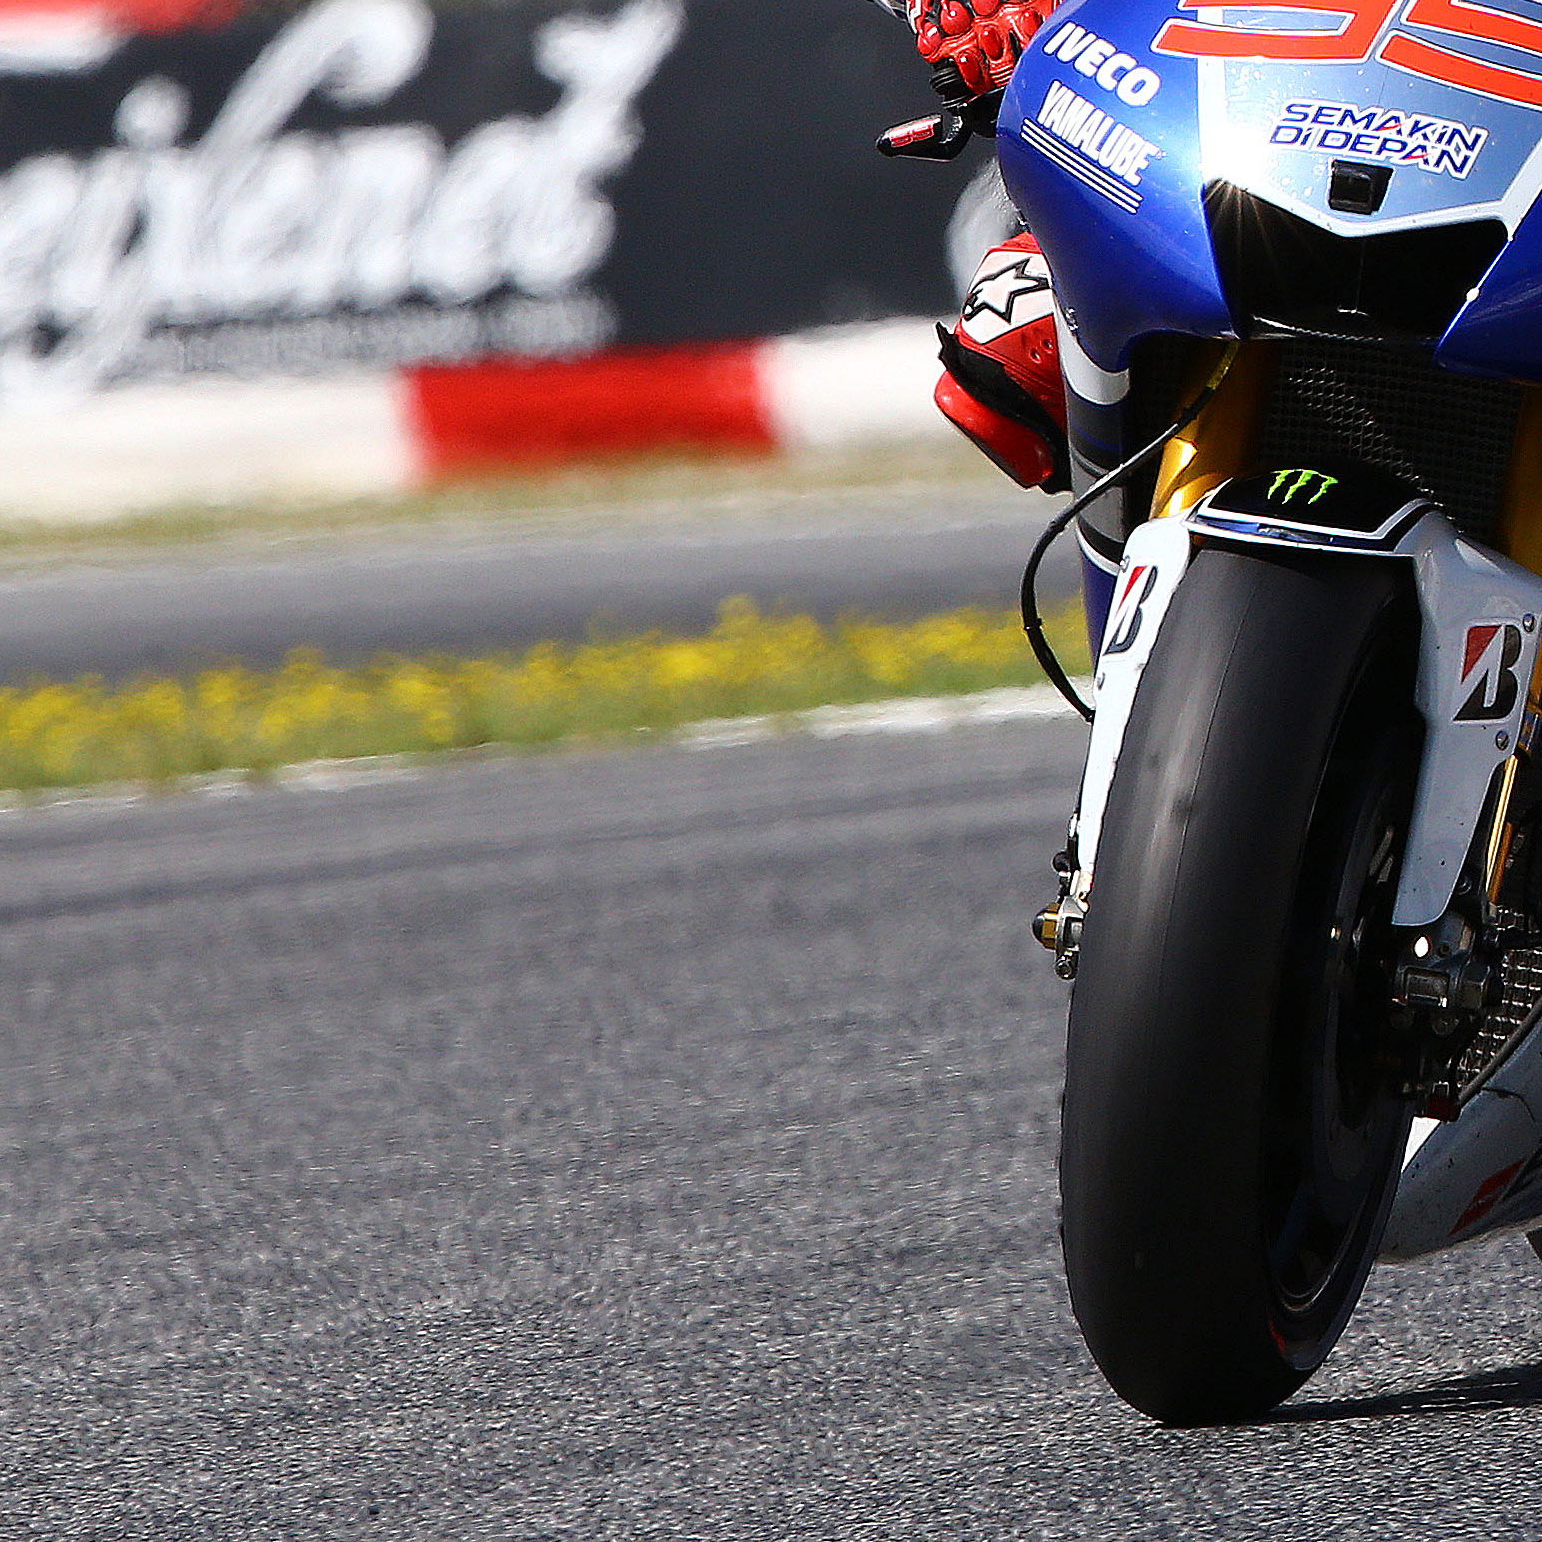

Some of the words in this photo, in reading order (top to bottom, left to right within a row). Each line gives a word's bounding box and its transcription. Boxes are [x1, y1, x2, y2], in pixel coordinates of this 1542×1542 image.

[1043, 20, 1161, 107] IVECO
[1036, 79, 1162, 187] YAMALUBE
[1282, 102, 1483, 152] SEMAKIN
